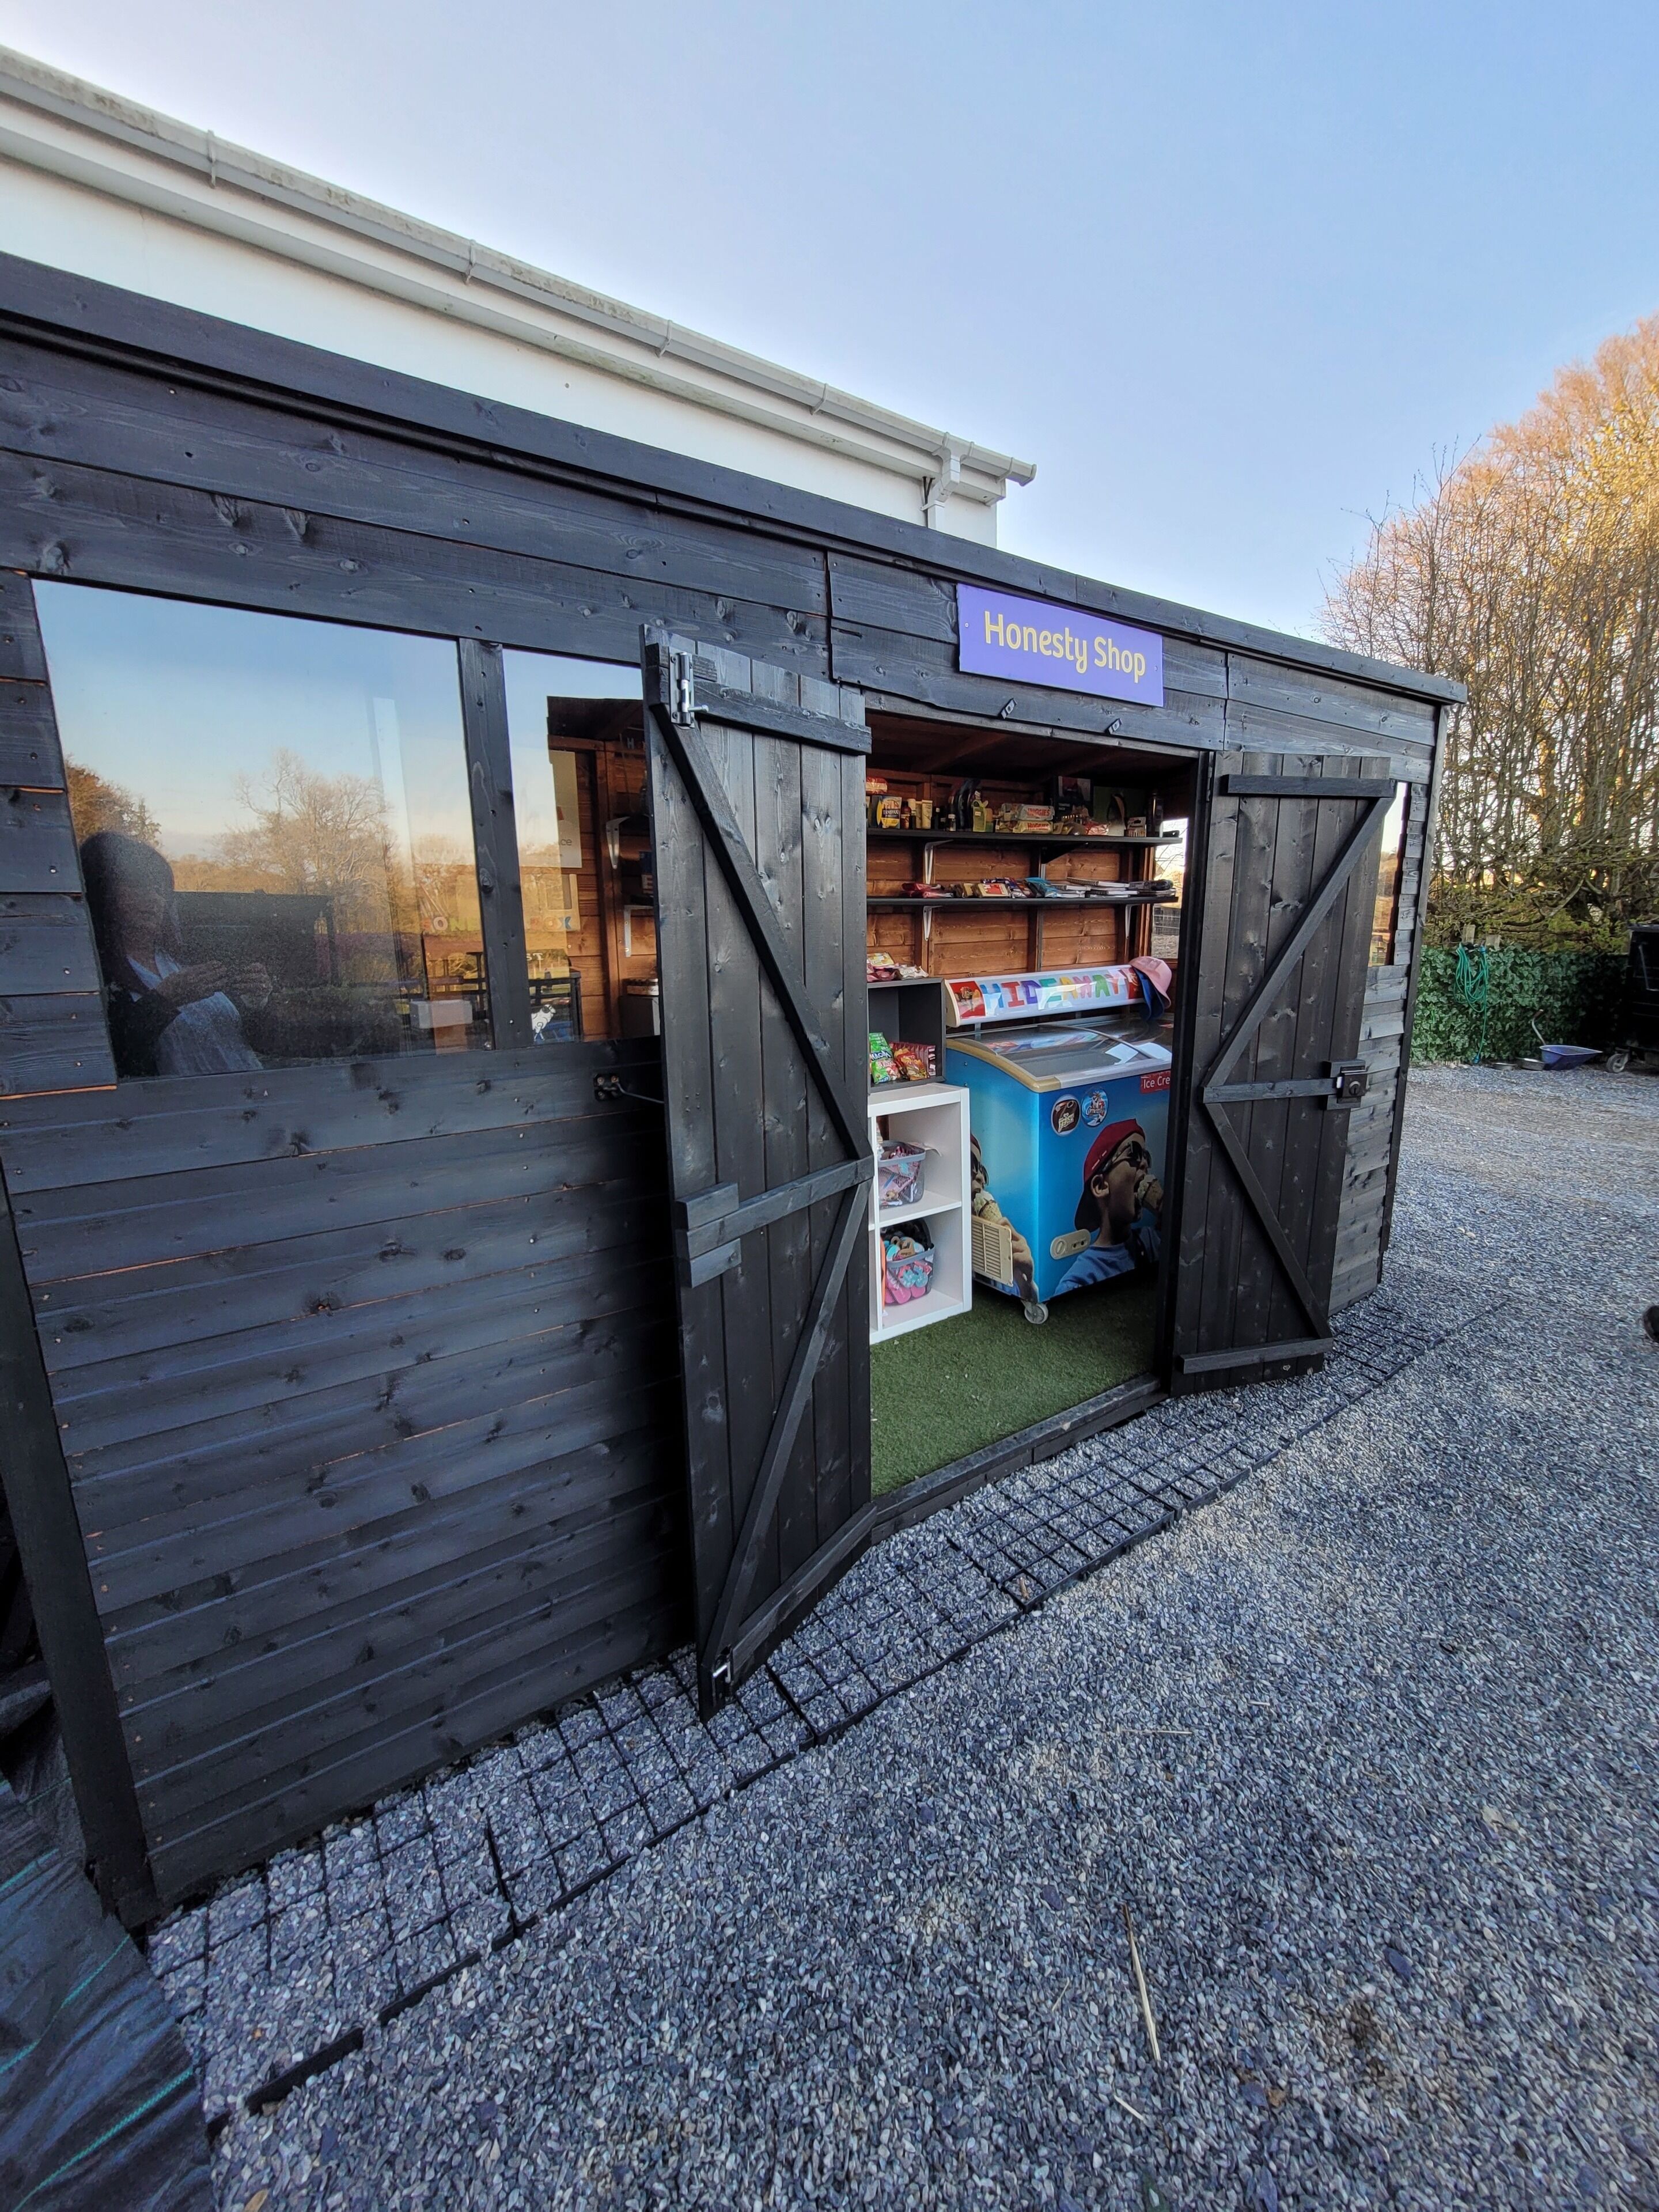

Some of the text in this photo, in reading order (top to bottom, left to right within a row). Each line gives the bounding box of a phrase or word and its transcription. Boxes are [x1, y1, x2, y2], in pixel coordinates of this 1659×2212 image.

[984, 611, 1146, 683] Honesty Shop
[1027, 807, 1050, 816] HUGGIES
[980, 970, 1123, 1012] HIDEAWAY
[1143, 1079, 1156, 1089] Ice
